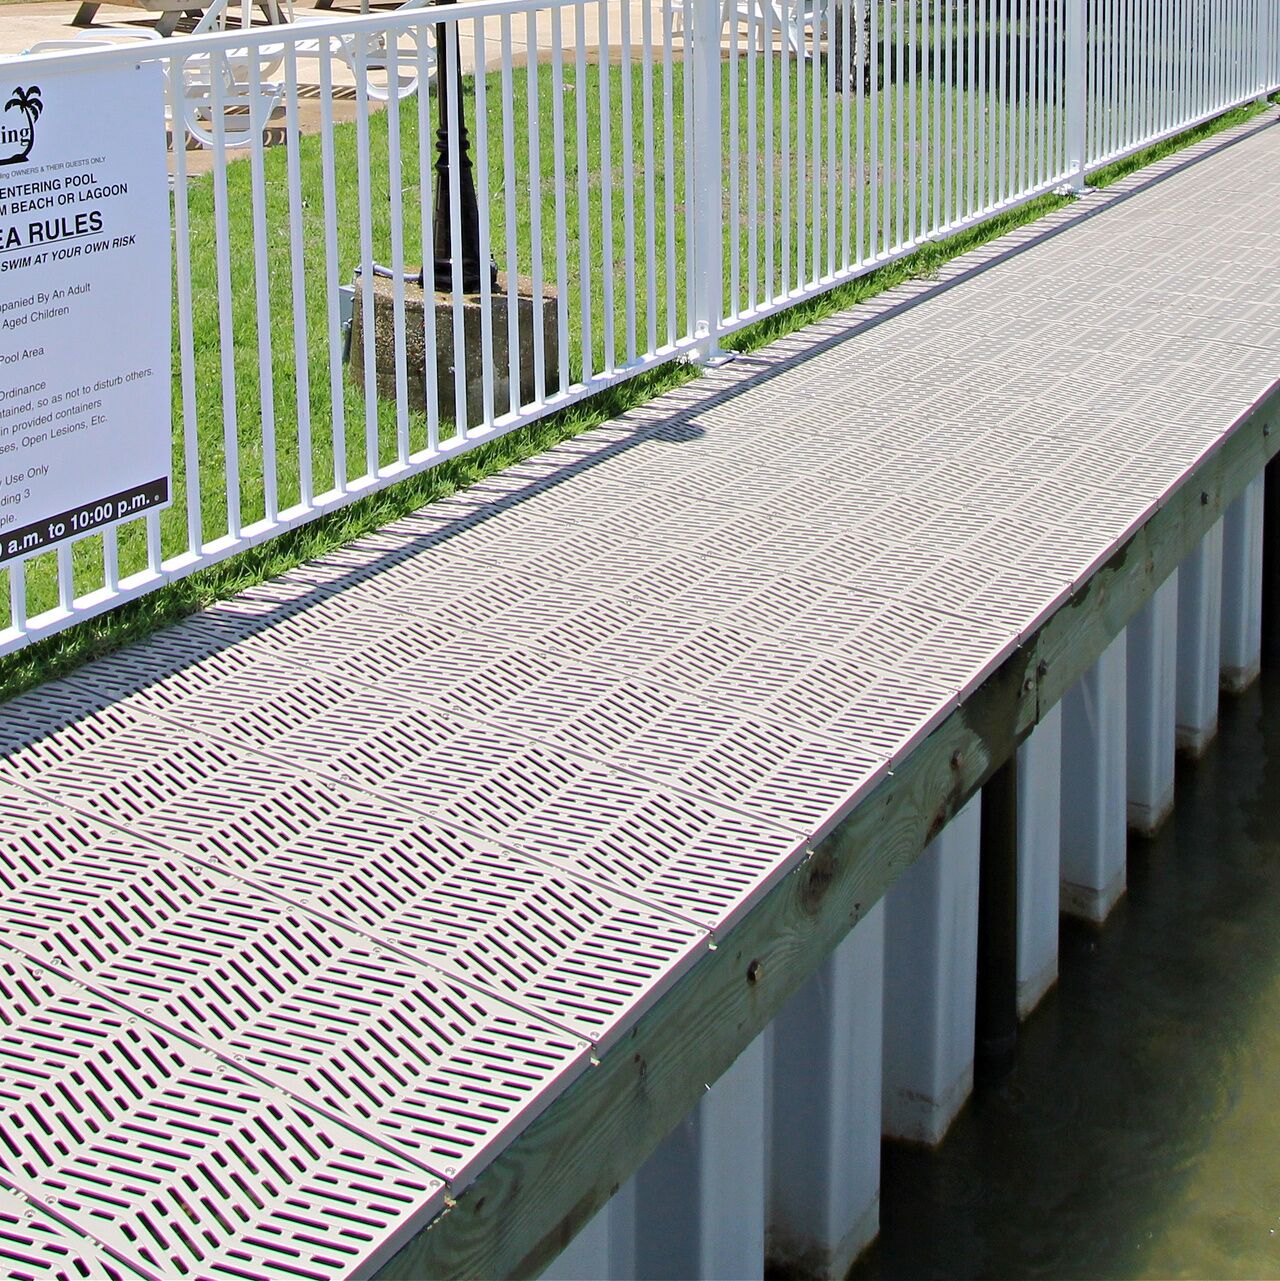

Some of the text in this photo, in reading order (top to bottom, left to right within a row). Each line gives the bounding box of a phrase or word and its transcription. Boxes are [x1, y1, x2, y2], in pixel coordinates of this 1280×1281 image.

[10, 166, 39, 177] OWNERS
[46, 162, 64, 171] THEIR
[65, 158, 89, 168] GUESTS
[90, 156, 106, 164] ONLY
[64, 173, 97, 188] POOL
[11, 196, 53, 214] BEACH
[57, 192, 75, 205] OR
[78, 183, 127, 201] LAGOON
[28, 210, 102, 243] RULES
[0, 256, 31, 272] SWIM
[33, 252, 48, 265] AT
[51, 246, 81, 261] YOUR
[84, 240, 109, 254] OWN
[112, 234, 136, 248] RISK
[37, 292, 49, 304] By
[52, 289, 65, 299] An
[67, 282, 90, 296] Adult
[1, 314, 27, 330] Aged
[30, 306, 69, 322] Children
[21, 347, 44, 360] Area
[37, 398, 49, 408] so
[51, 394, 62, 404] as
[65, 387, 79, 399] not
[82, 385, 91, 394] to
[93, 375, 123, 391] disturb
[0, 426, 9, 436] in
[12, 411, 52, 435] provided
[55, 399, 102, 420] containers
[21, 433, 47, 447] Open
[50, 421, 88, 438] Lesions,
[91, 415, 107, 426] Etc.
[5, 473, 24, 486] Use
[27, 464, 49, 478] Only
[24, 488, 30, 498] 3
[8, 532, 43, 554] a.m.
[48, 523, 65, 538] to
[70, 502, 112, 530] 10:00
[117, 493, 150, 517] p.m.
